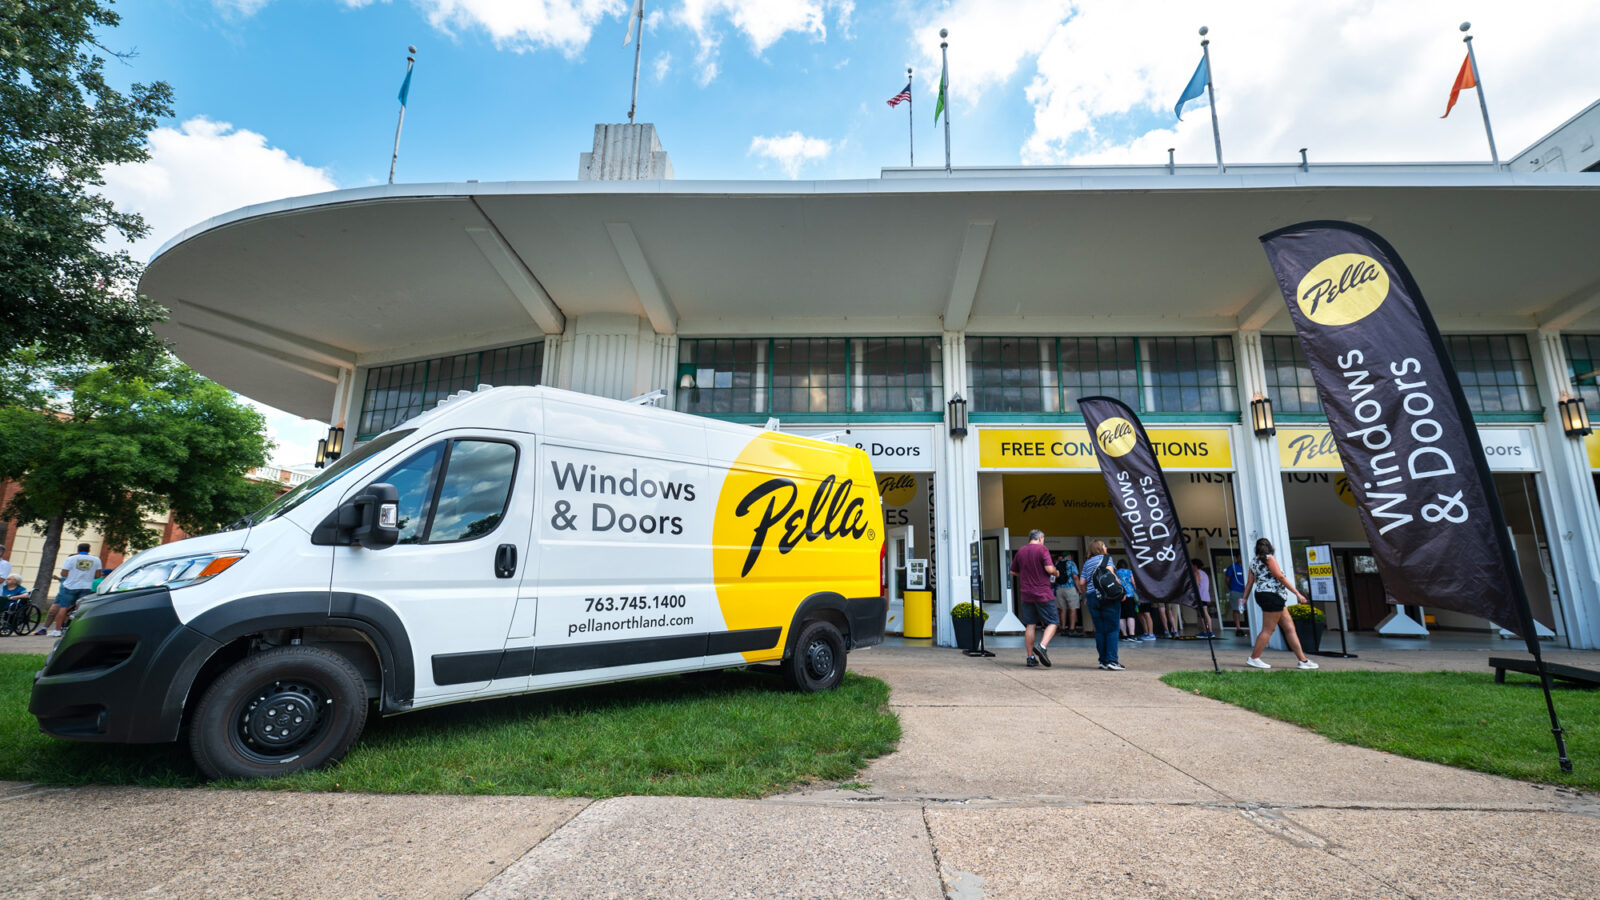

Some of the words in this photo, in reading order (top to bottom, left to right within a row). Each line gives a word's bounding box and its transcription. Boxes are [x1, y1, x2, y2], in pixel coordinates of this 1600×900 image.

[1302, 261, 1380, 316] Pella
[1099, 422, 1132, 450] Pella
[1390, 357, 1456, 480] Doors
[871, 443, 920, 456] Doors
[1001, 442, 1046, 456] FREE
[1051, 442, 1209, 456] CONTIONS
[1288, 431, 1339, 466] Pell
[1337, 349, 1414, 536] Windows
[1485, 444, 1522, 456] oors
[551, 460, 696, 502] Windows
[879, 474, 914, 496] Pella
[550, 500, 578, 531] &
[591, 503, 684, 536] Doors
[1021, 492, 1057, 513] Pella
[1063, 500, 1106, 509] Windows
[1116, 470, 1154, 569] Windows
[1139, 475, 1170, 540] Doors
[1420, 489, 1469, 524] &
[735, 474, 869, 578] Pella
[1156, 543, 1176, 562] &
[584, 594, 687, 613] 763.745.1400
[568, 614, 694, 637] pellanorthland.com
